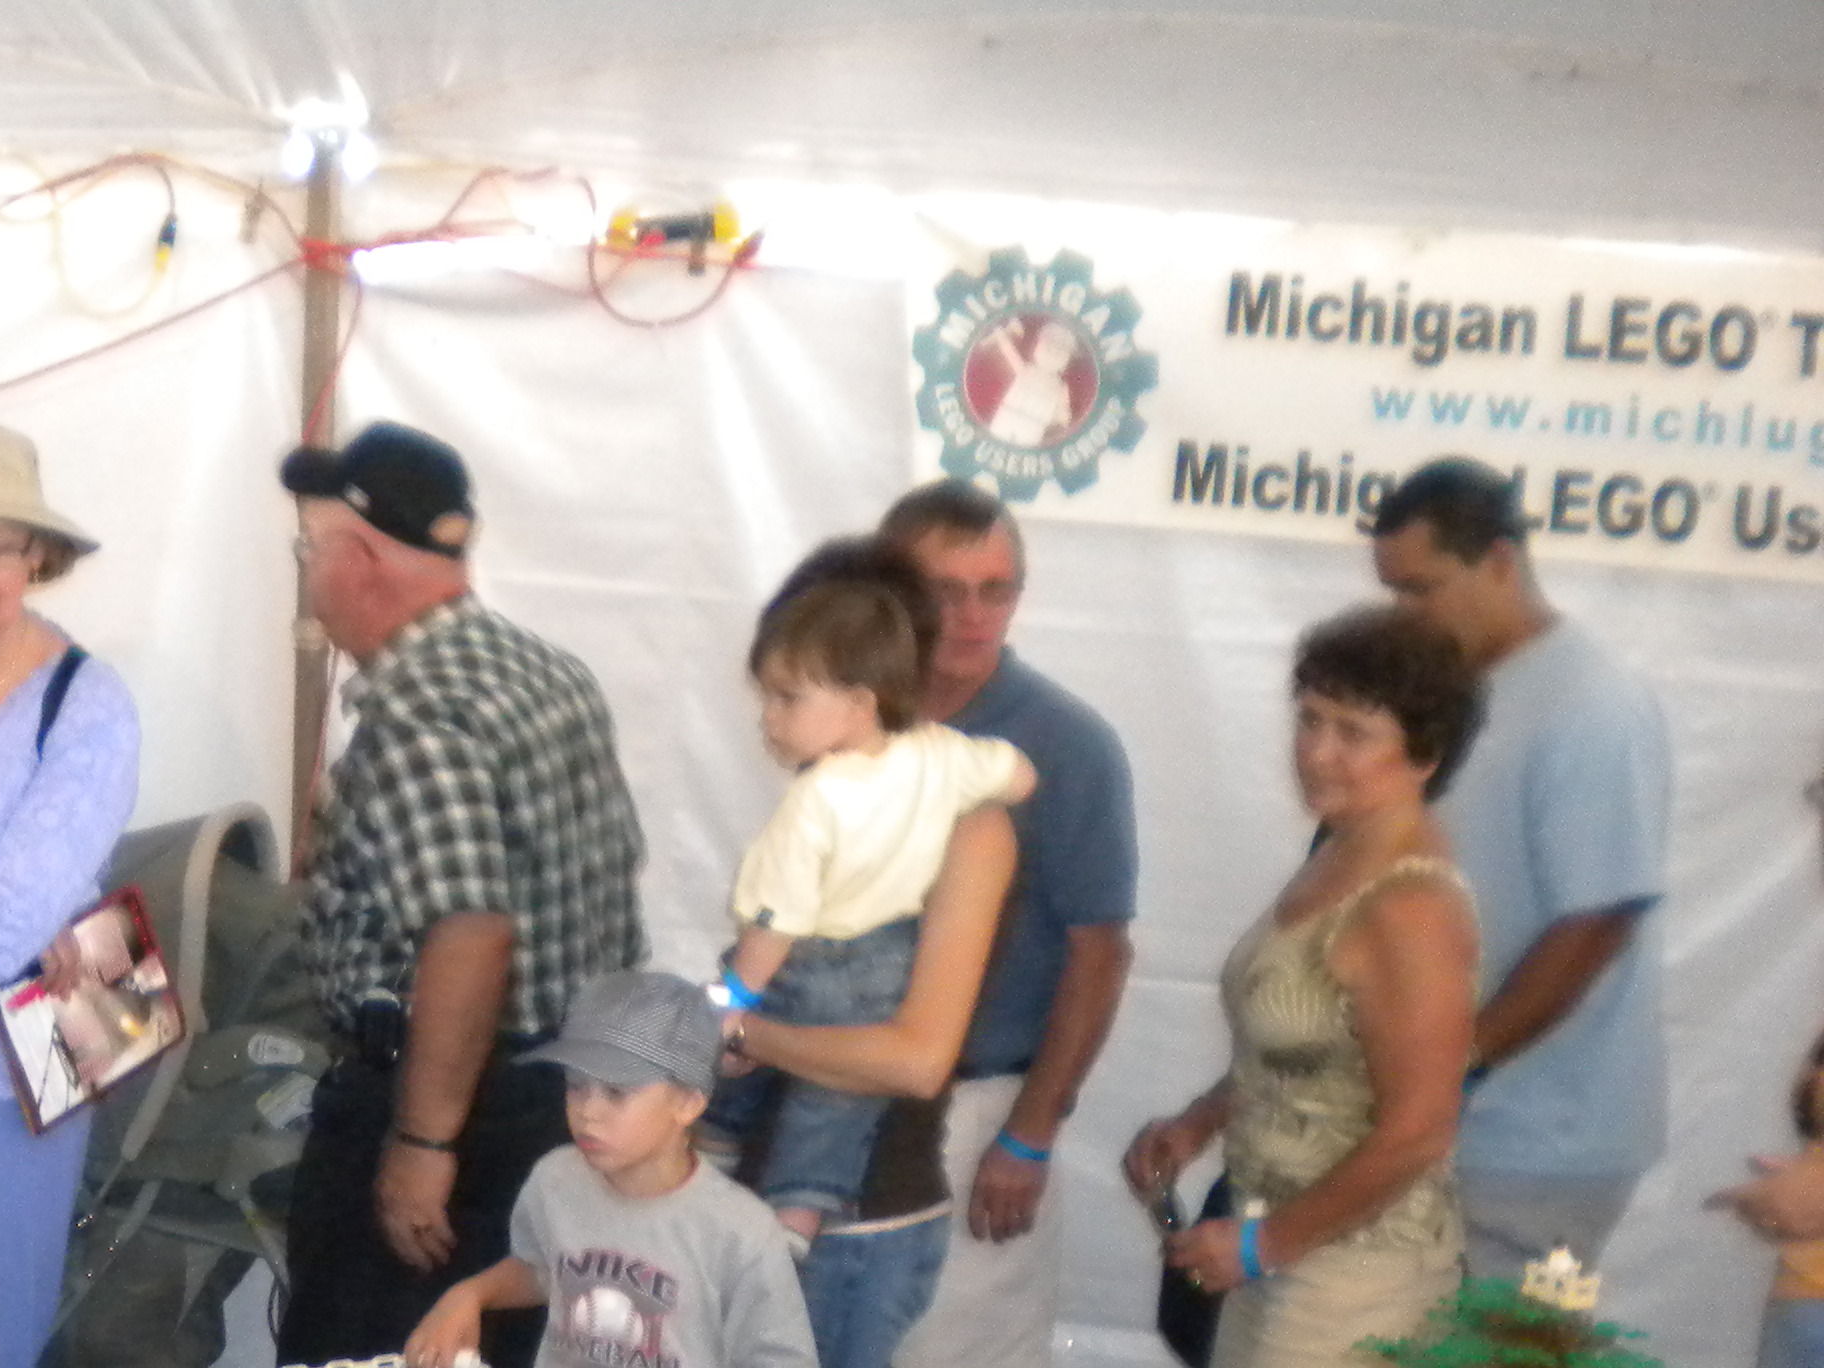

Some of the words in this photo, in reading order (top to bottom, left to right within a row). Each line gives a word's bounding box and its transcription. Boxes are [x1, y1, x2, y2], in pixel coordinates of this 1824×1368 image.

[938, 271, 1133, 365] MICHIGAN
[1225, 269, 1537, 367] Michigan
[973, 441, 1055, 476] USERS
[1172, 437, 1397, 536] Michig
[556, 1250, 678, 1302] NIKE
